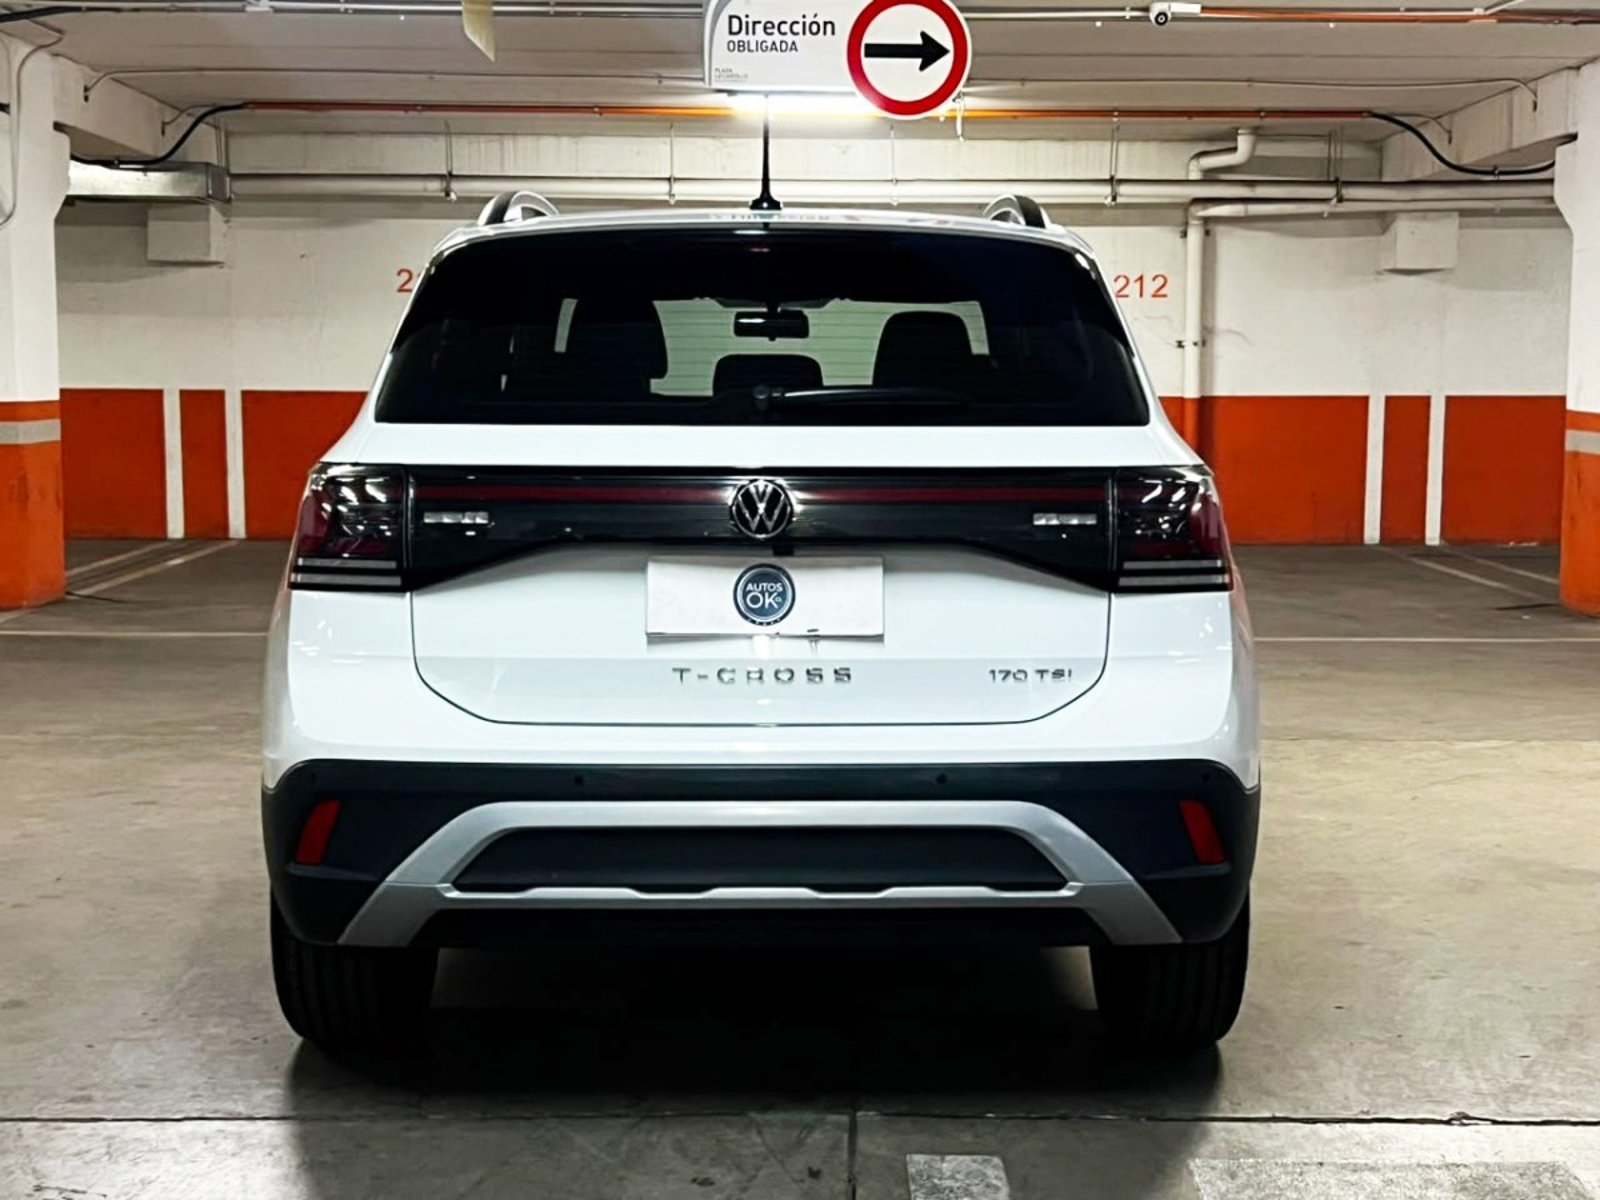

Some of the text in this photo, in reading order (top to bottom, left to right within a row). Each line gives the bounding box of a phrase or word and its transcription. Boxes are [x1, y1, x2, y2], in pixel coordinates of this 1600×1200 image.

[727, 13, 836, 36] Dirección
[726, 39, 799, 53] OBLIGADA
[1113, 273, 1168, 298] 212
[746, 582, 783, 592] AUTOS
[672, 667, 852, 684] T-CROSS
[989, 668, 1072, 683] 170 TSI
